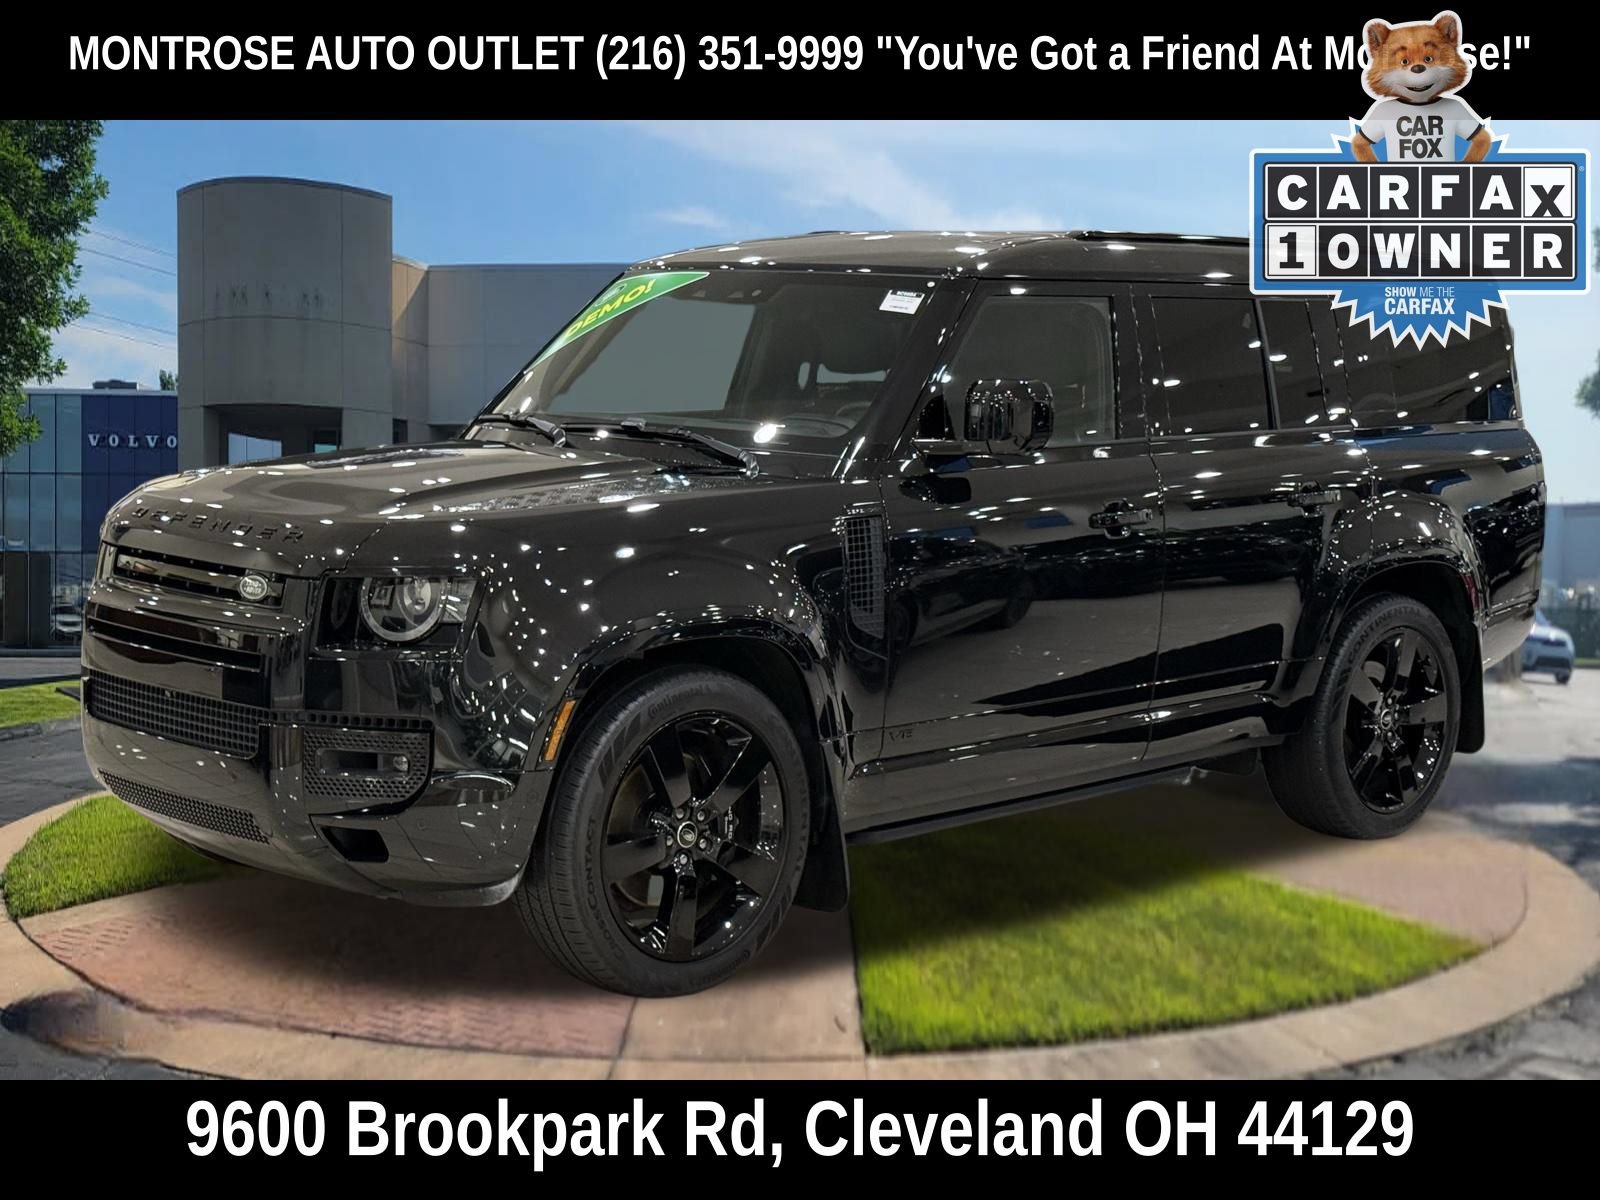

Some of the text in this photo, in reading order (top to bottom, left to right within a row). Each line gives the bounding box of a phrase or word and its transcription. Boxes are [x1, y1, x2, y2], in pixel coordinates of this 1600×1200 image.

[566, 279, 656, 338] DEMO!
[88, 434, 177, 449] VOLVO
[131, 507, 304, 543] DEFENDER
